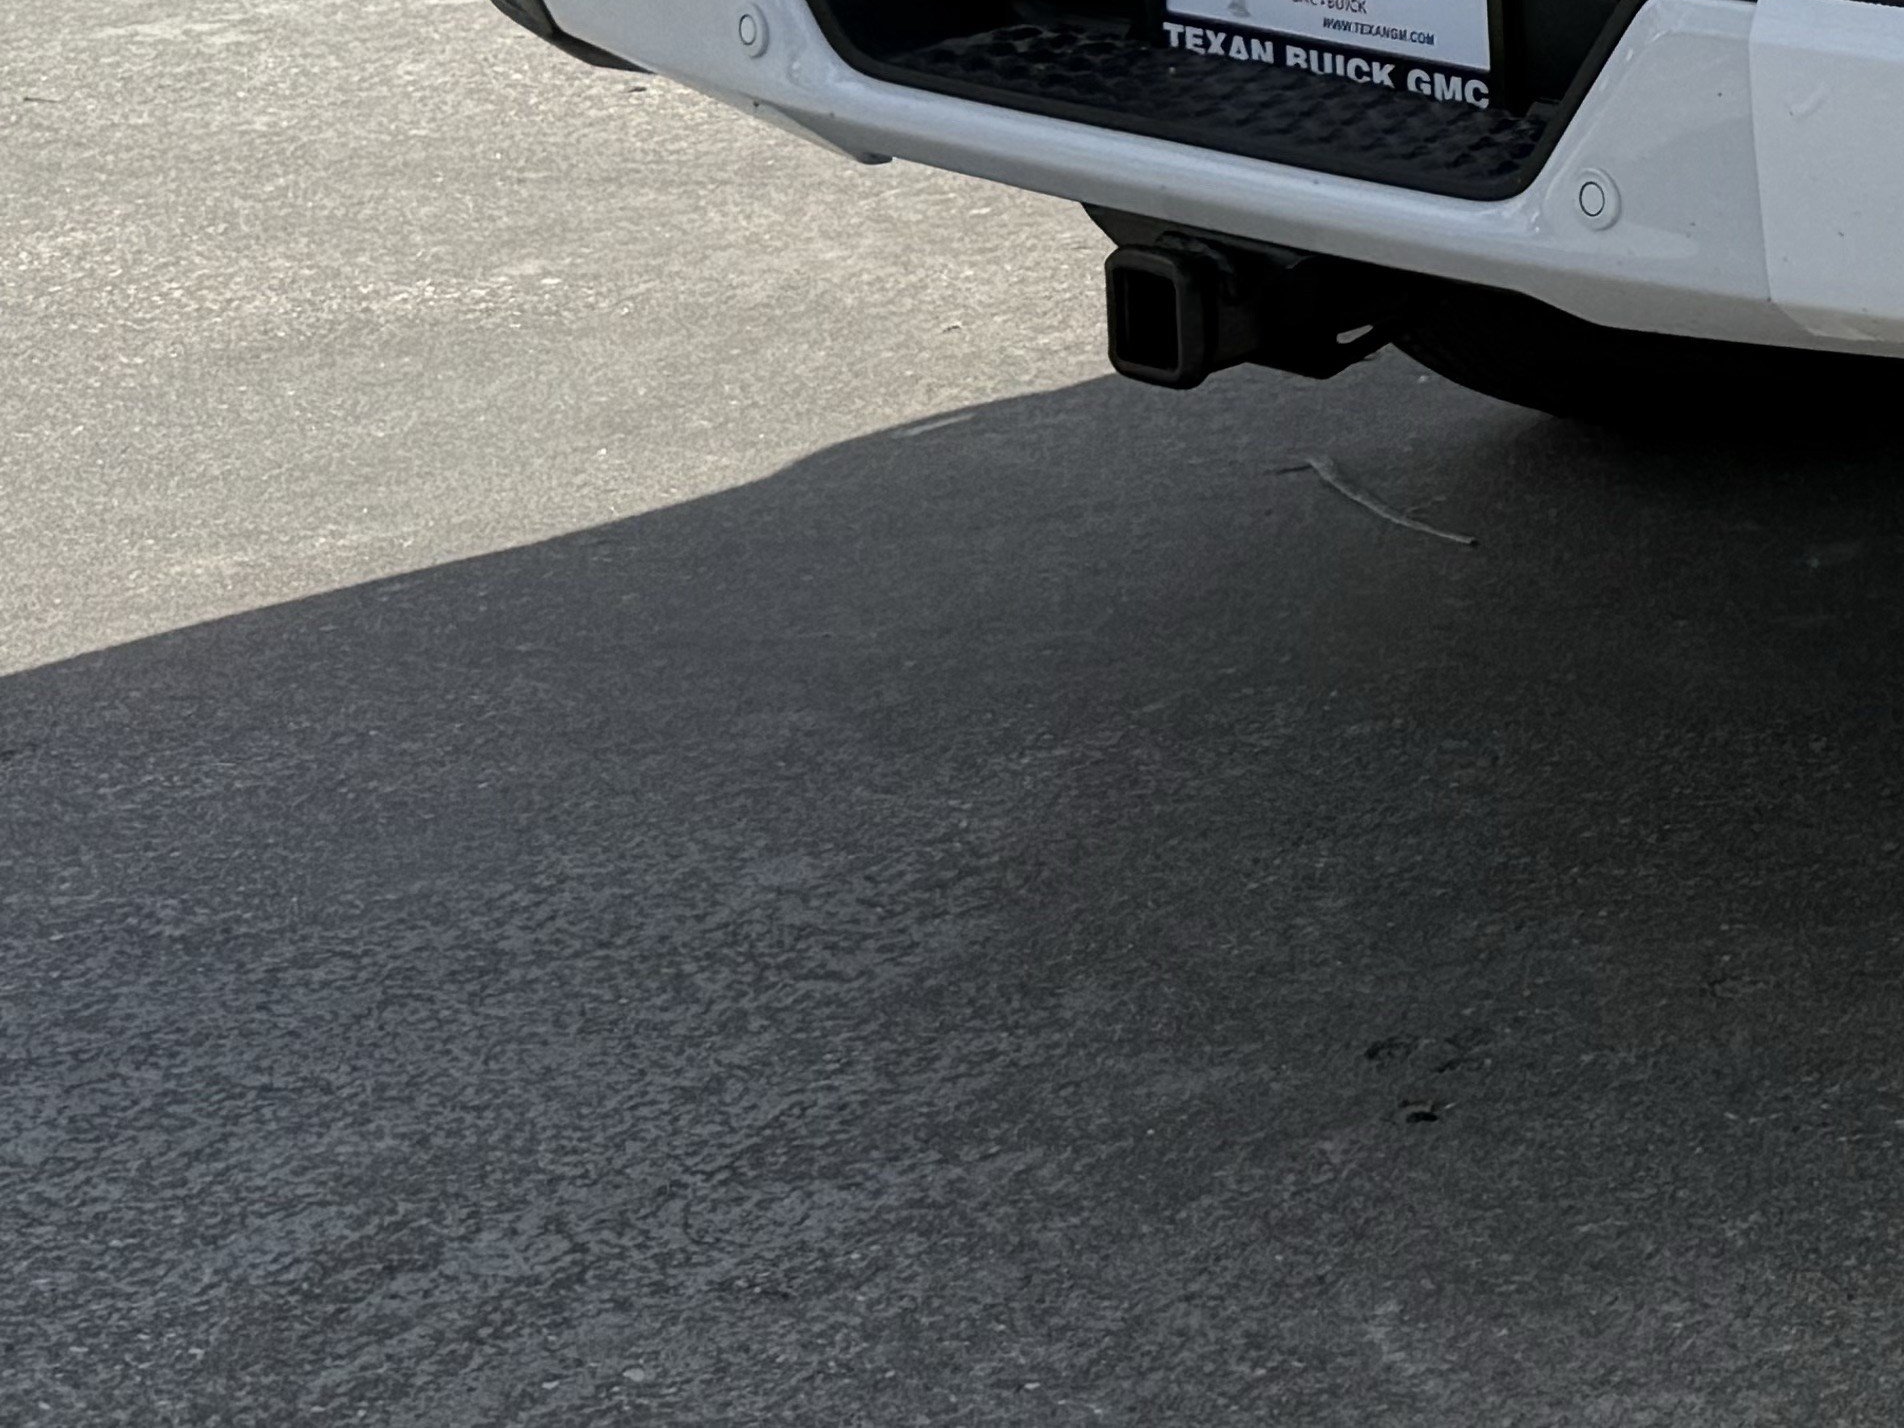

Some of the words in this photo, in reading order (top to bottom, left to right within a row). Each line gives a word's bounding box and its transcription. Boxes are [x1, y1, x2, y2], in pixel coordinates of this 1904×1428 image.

[1162, 21, 1275, 65] TEXAN
[1285, 45, 1395, 89] BUICK
[1406, 68, 1491, 110] GMC
